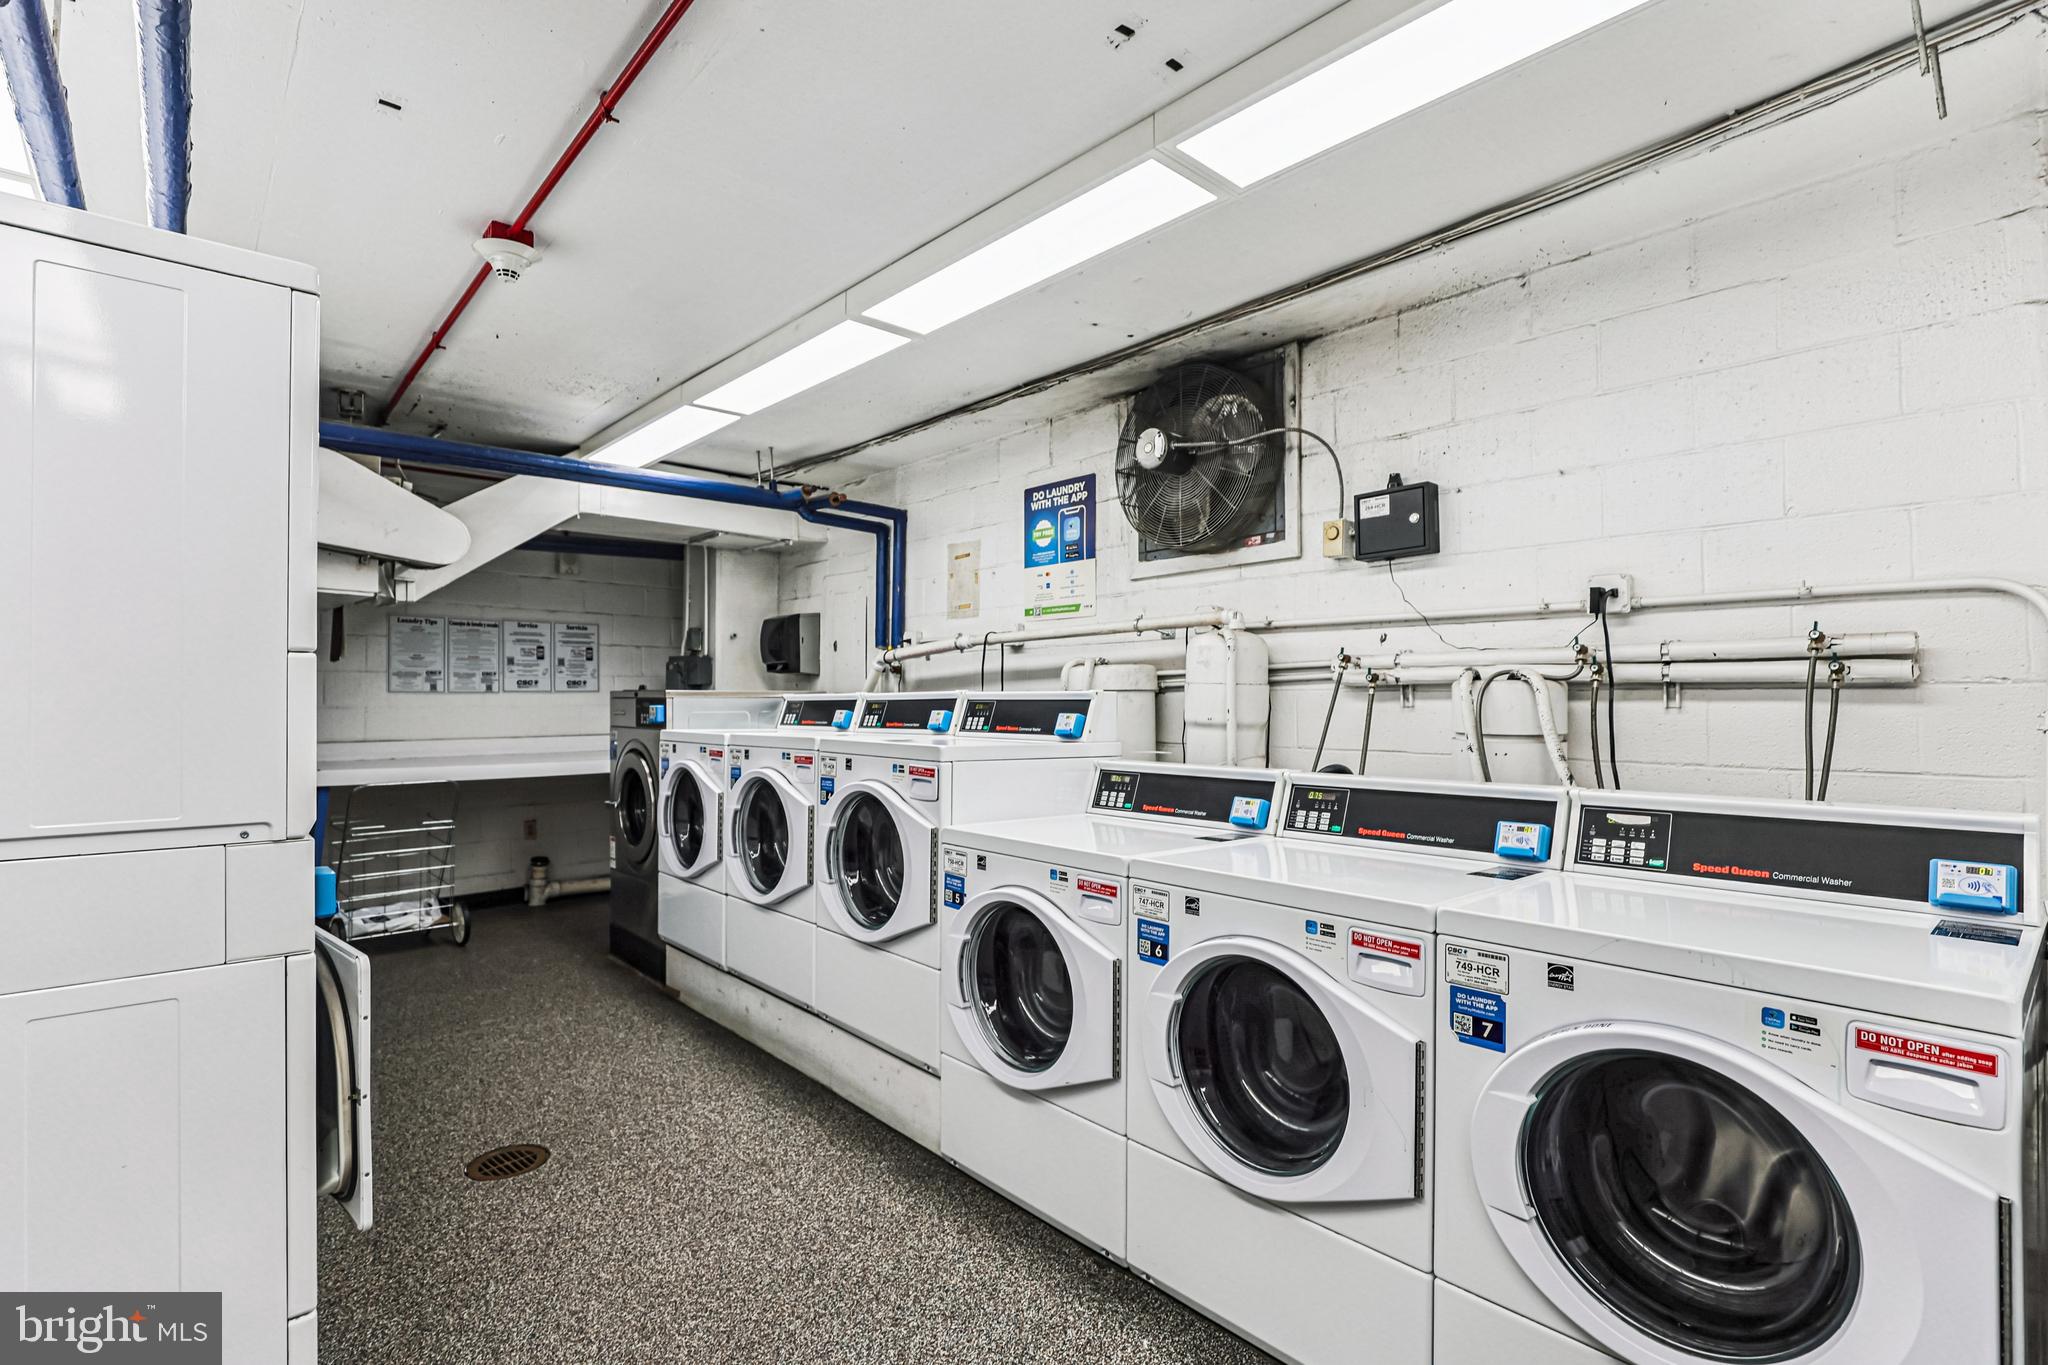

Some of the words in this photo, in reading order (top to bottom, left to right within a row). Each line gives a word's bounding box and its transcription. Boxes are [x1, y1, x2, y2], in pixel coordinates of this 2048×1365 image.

[1033, 491, 1045, 501] DO
[1046, 481, 1086, 498] LAUNDRY
[1031, 498, 1052, 511] WITH
[1053, 495, 1069, 506] THE
[1071, 491, 1088, 503] APP
[397, 617, 423, 625] Laundry
[1358, 827, 1381, 836] Speed
[1381, 829, 1405, 839] Queen
[1406, 833, 1435, 842] Commercial
[1436, 836, 1455, 844] Washer
[1693, 862, 1729, 874] Speed
[1731, 865, 1770, 878] Queen
[1772, 871, 1819, 884] Commercial
[1821, 876, 1852, 887] Washer
[955, 893, 960, 903] 5
[1139, 897, 1164, 909] 747-HCR
[1353, 932, 1362, 941] DO
[1363, 934, 1375, 943] NOT
[1376, 937, 1393, 947] OPEN
[1155, 944, 1162, 957] 6
[1447, 946, 1463, 954] CSC
[1456, 960, 1500, 978] 749-HCR
[1456, 998, 1471, 1006] WITH
[1467, 995, 1497, 1005] LAUNDRY
[1481, 1021, 1494, 1038] 7
[1860, 1031, 1876, 1042] DO
[1880, 1035, 1904, 1048] NOT
[1907, 1040, 1940, 1055] OPEN
[1941, 1051, 1955, 1059] after
[1956, 1054, 1977, 1064] adding
[1978, 1058, 1993, 1067] soap
[1906, 1050, 1929, 1061] despues
[1957, 1060, 1974, 1069] jabon
